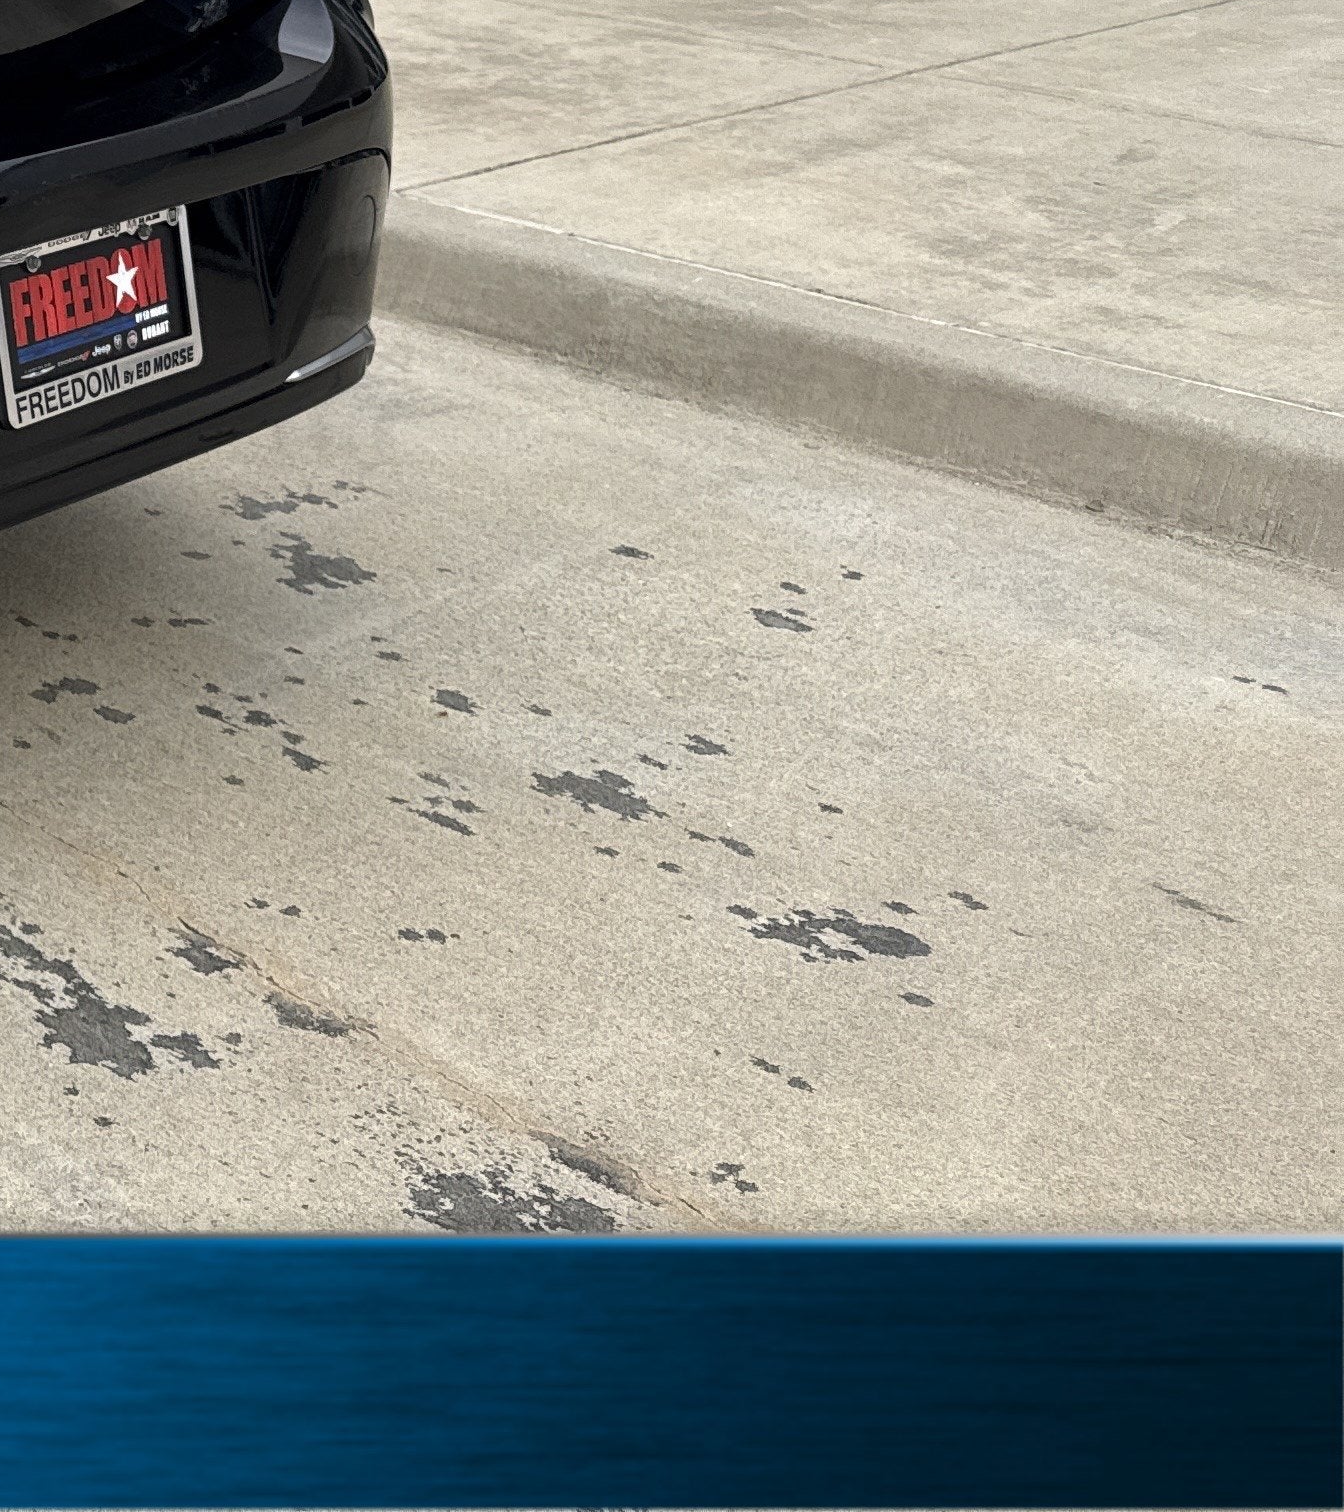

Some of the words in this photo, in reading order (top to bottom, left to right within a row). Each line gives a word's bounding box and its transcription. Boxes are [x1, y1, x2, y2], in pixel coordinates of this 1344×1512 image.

[9, 239, 169, 348] FREEDOM
[15, 364, 121, 424] FREEDOM
[123, 370, 135, 385] By
[136, 359, 151, 380] ED
[153, 345, 195, 375] MORSE
[92, 343, 111, 357] Jeep
